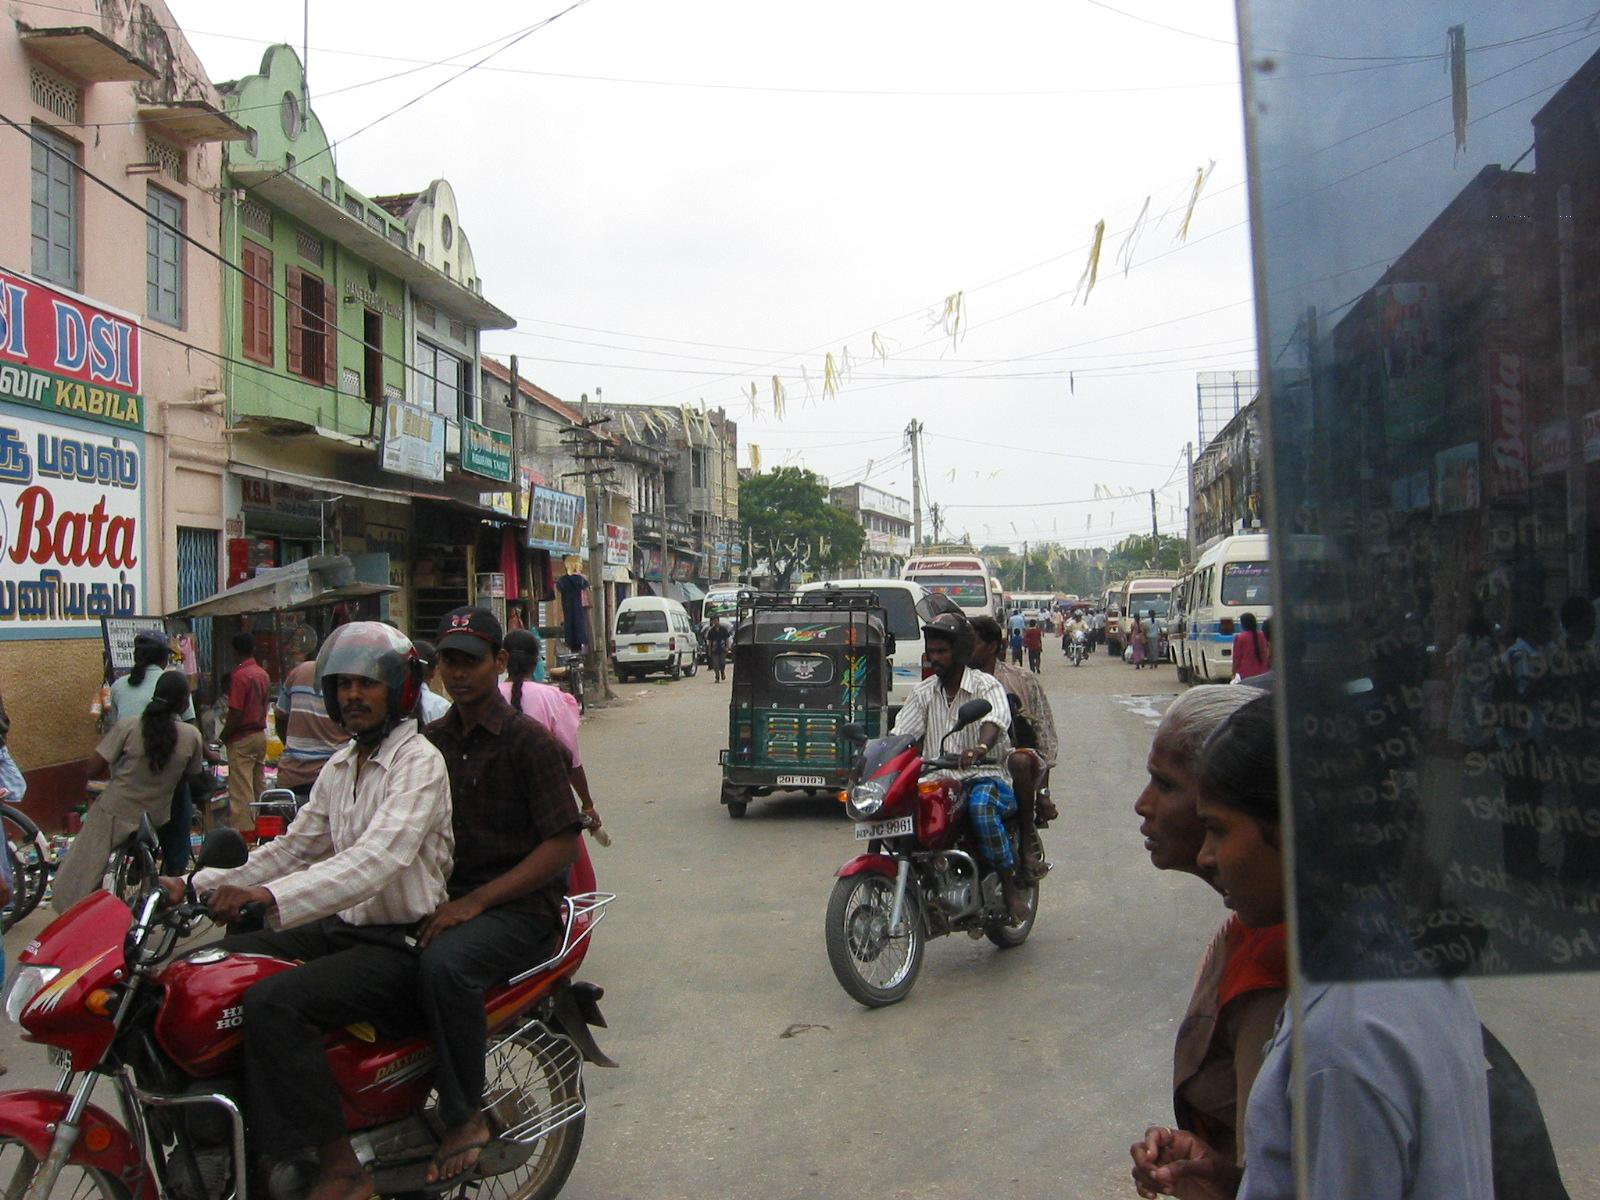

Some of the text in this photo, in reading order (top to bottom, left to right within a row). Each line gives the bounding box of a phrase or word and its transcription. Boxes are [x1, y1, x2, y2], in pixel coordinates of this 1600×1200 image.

[0, 278, 133, 387] I DSI
[55, 380, 140, 423] KABILA
[8, 485, 138, 569] Bata
